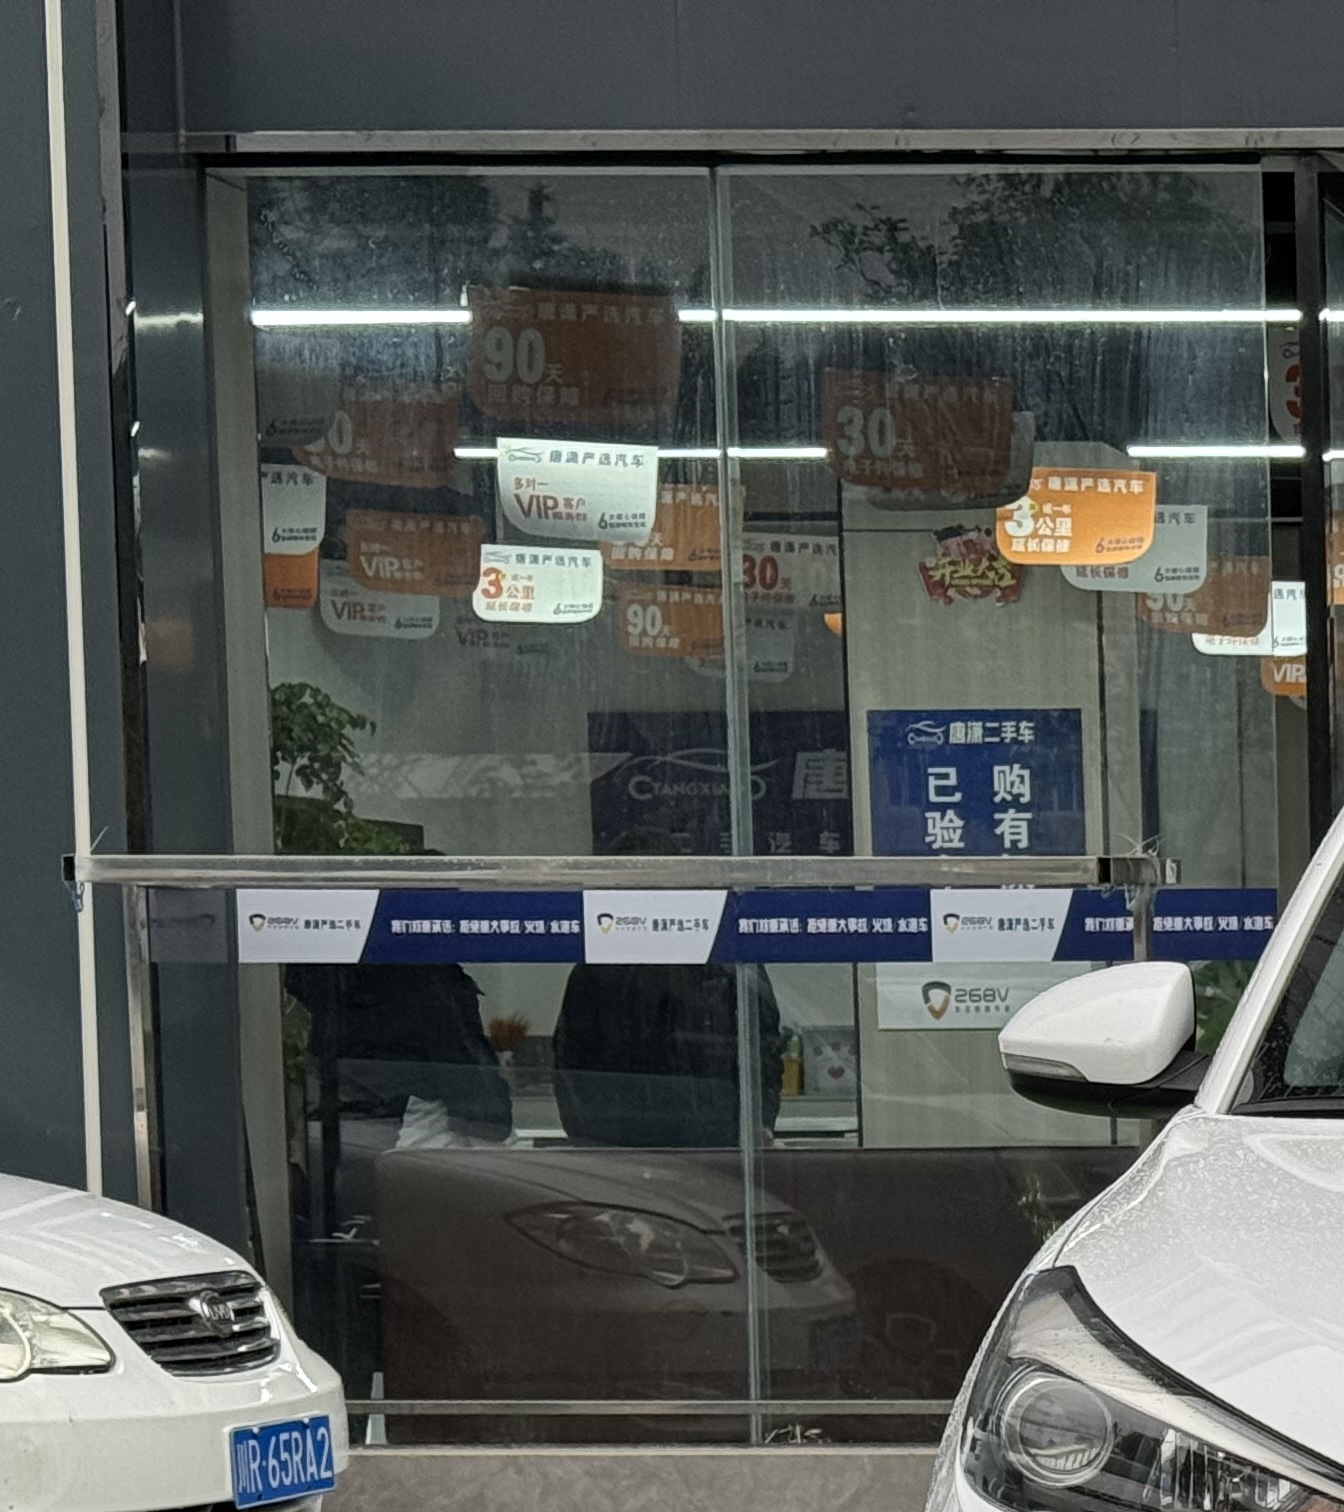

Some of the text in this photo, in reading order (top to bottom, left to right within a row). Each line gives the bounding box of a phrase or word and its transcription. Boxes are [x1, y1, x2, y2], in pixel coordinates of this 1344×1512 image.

[513, 476, 549, 491] 多对一
[513, 494, 559, 521] VIP
[1035, 517, 1073, 537] 公里
[359, 556, 400, 579] VIP
[506, 584, 536, 600] 公里
[331, 600, 365, 621] VIP
[954, 987, 1010, 1003] 268V
